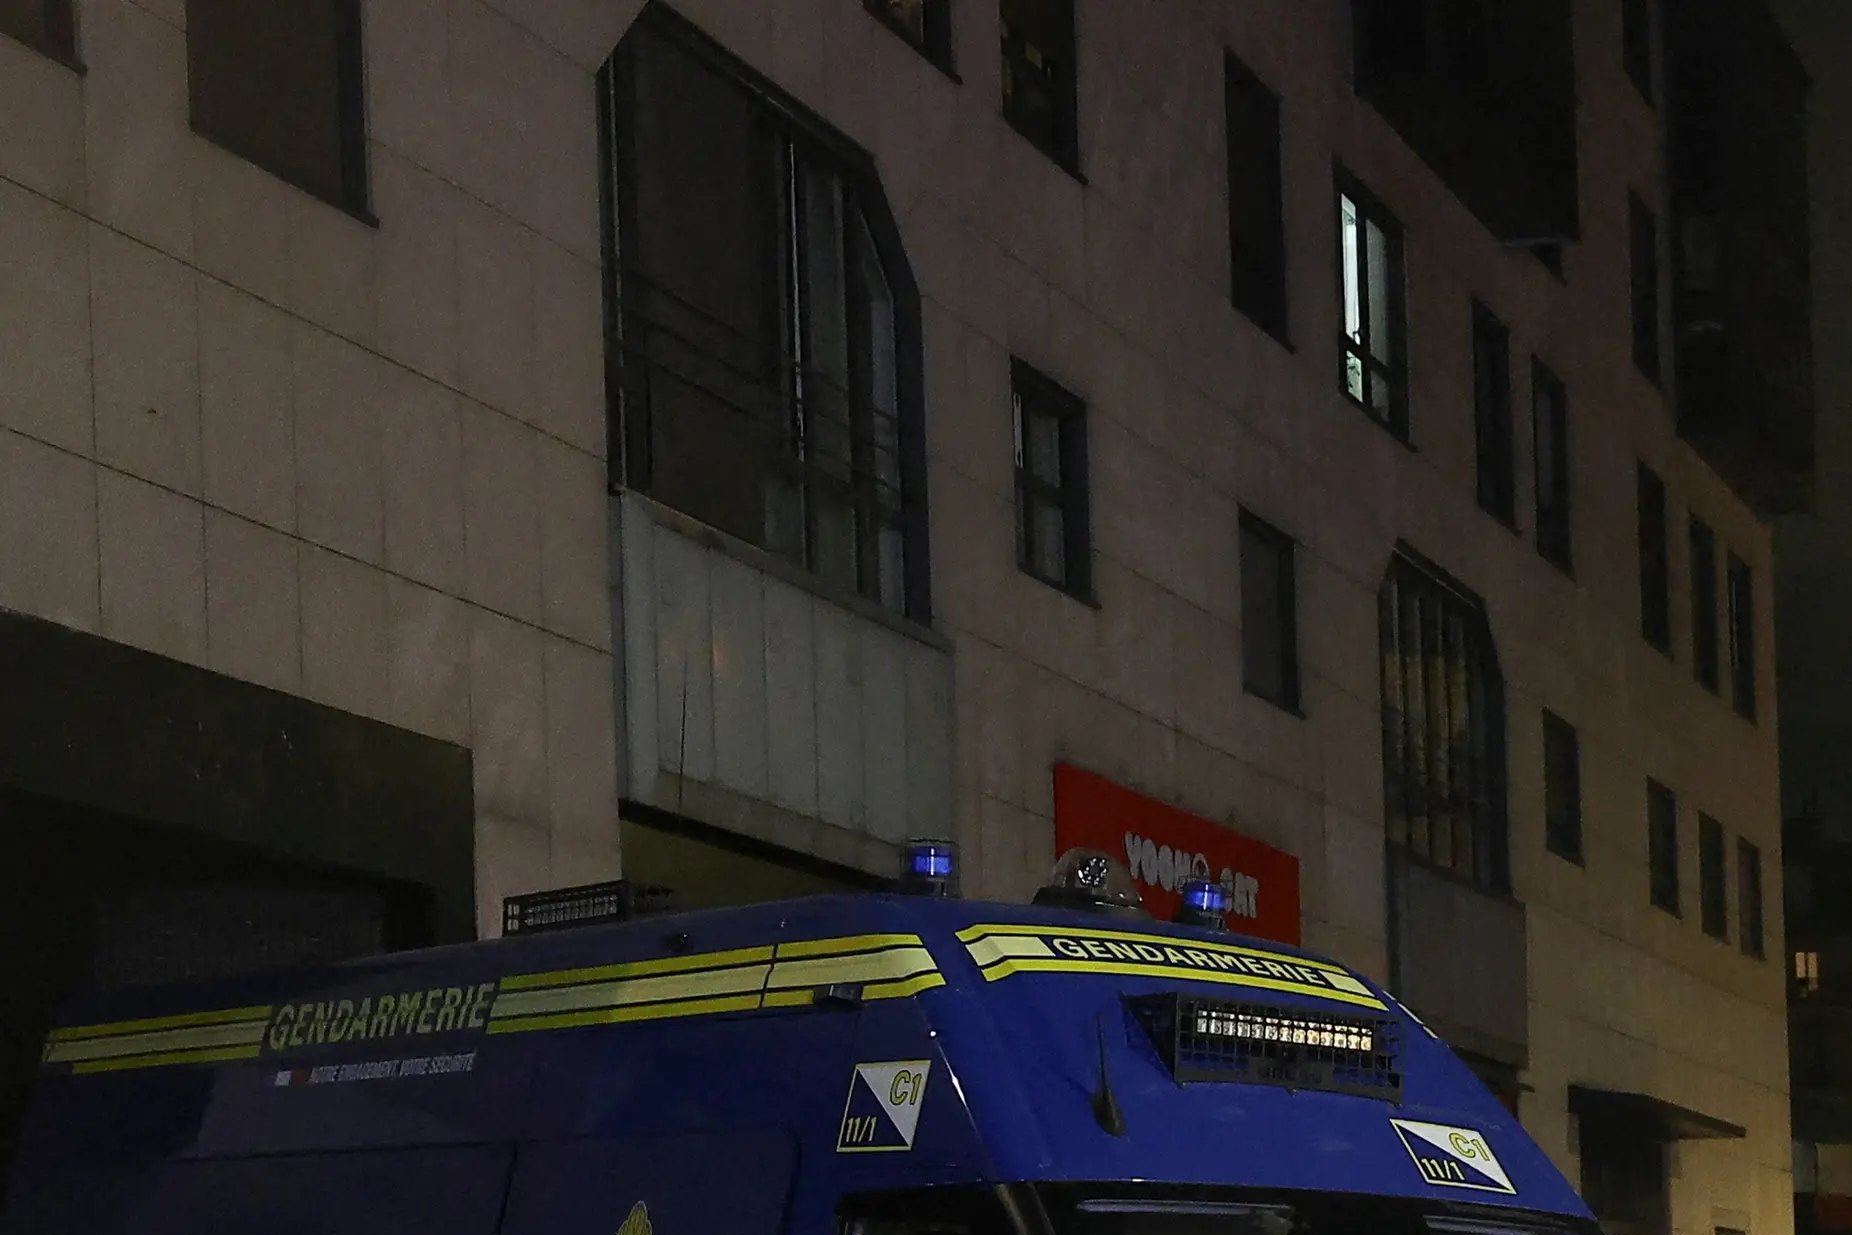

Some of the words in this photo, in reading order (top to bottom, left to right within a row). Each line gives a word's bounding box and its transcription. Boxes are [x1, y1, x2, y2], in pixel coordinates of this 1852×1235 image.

[1052, 937, 1326, 986] GENDARMERIE
[269, 981, 496, 1051] GENDARMERIE
[889, 1069, 922, 1106] C1
[845, 1115, 878, 1143] 11/1
[1448, 1132, 1490, 1162] C1
[1420, 1156, 1465, 1181] 11/1
